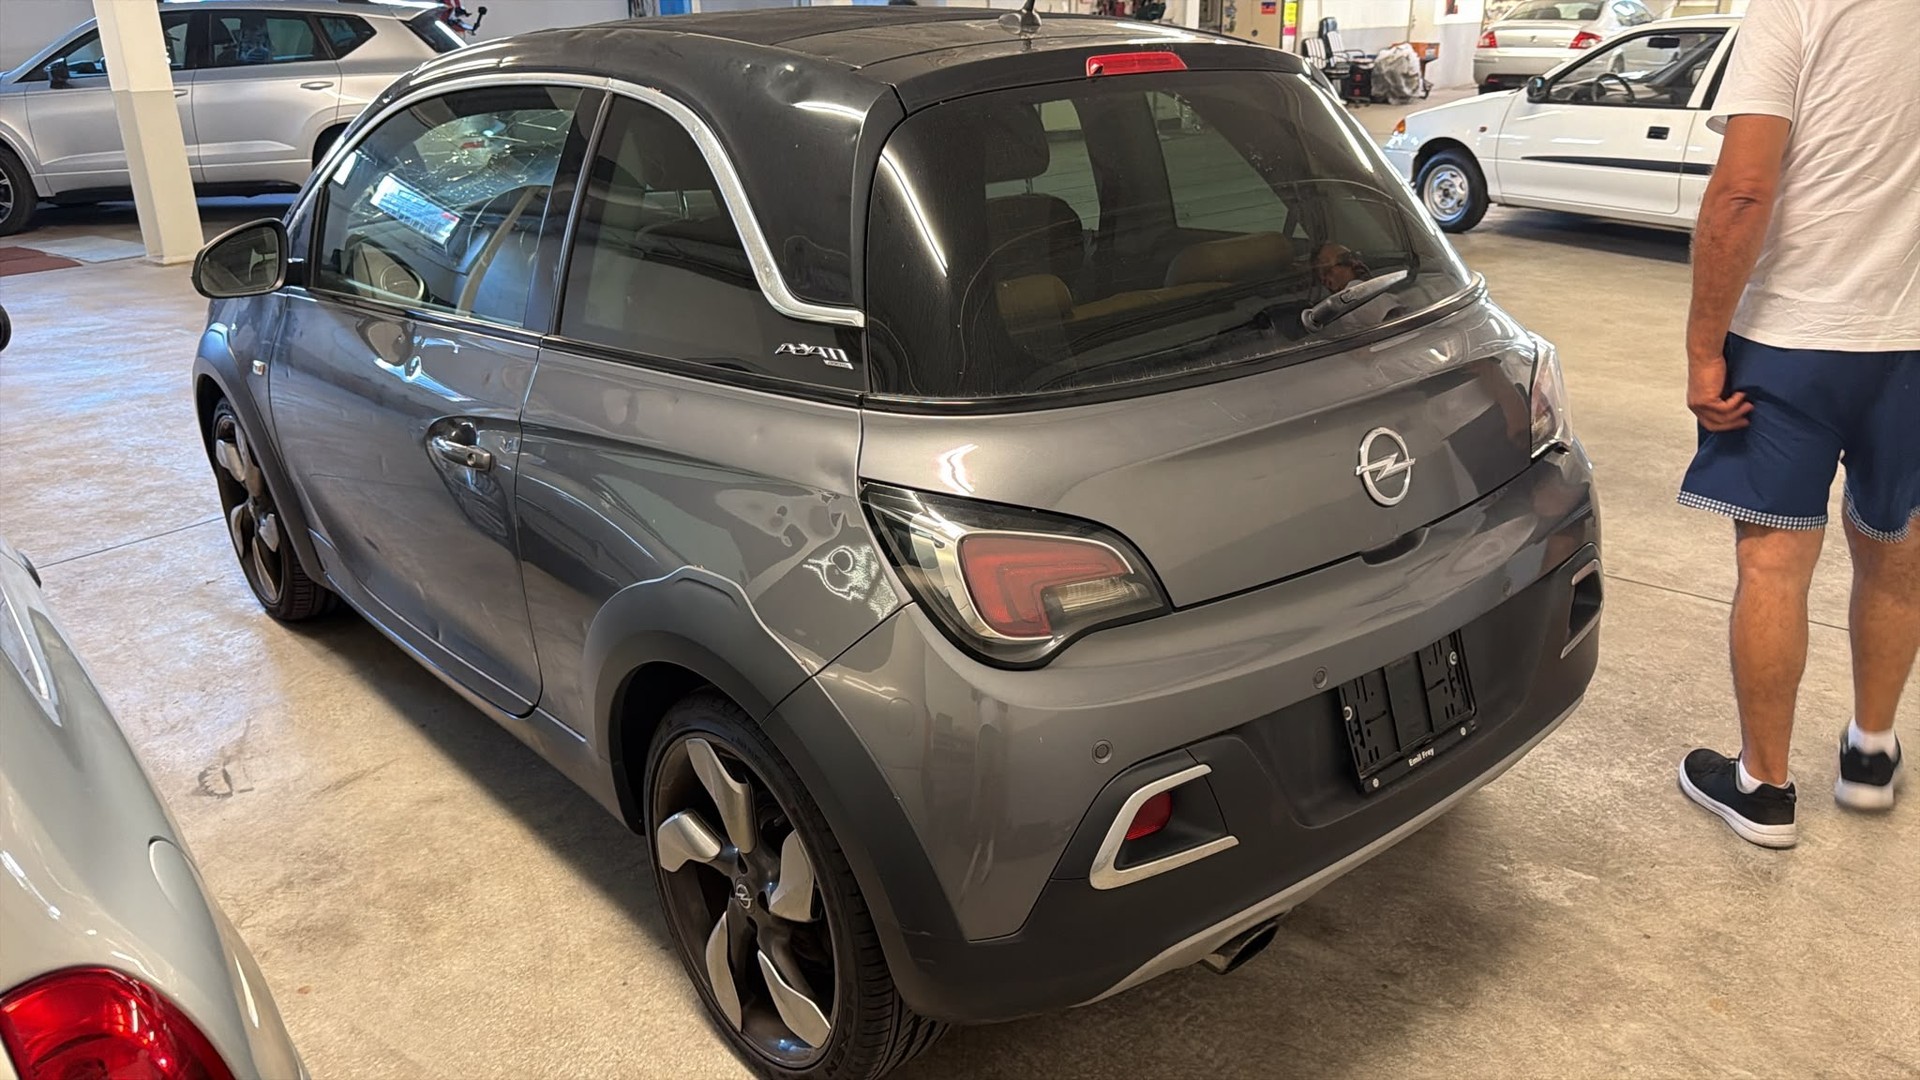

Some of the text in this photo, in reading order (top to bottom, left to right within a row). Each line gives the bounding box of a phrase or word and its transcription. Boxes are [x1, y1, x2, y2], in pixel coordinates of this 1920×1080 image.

[775, 343, 849, 362] ADAM
[1409, 747, 1434, 766] Emil Frey
